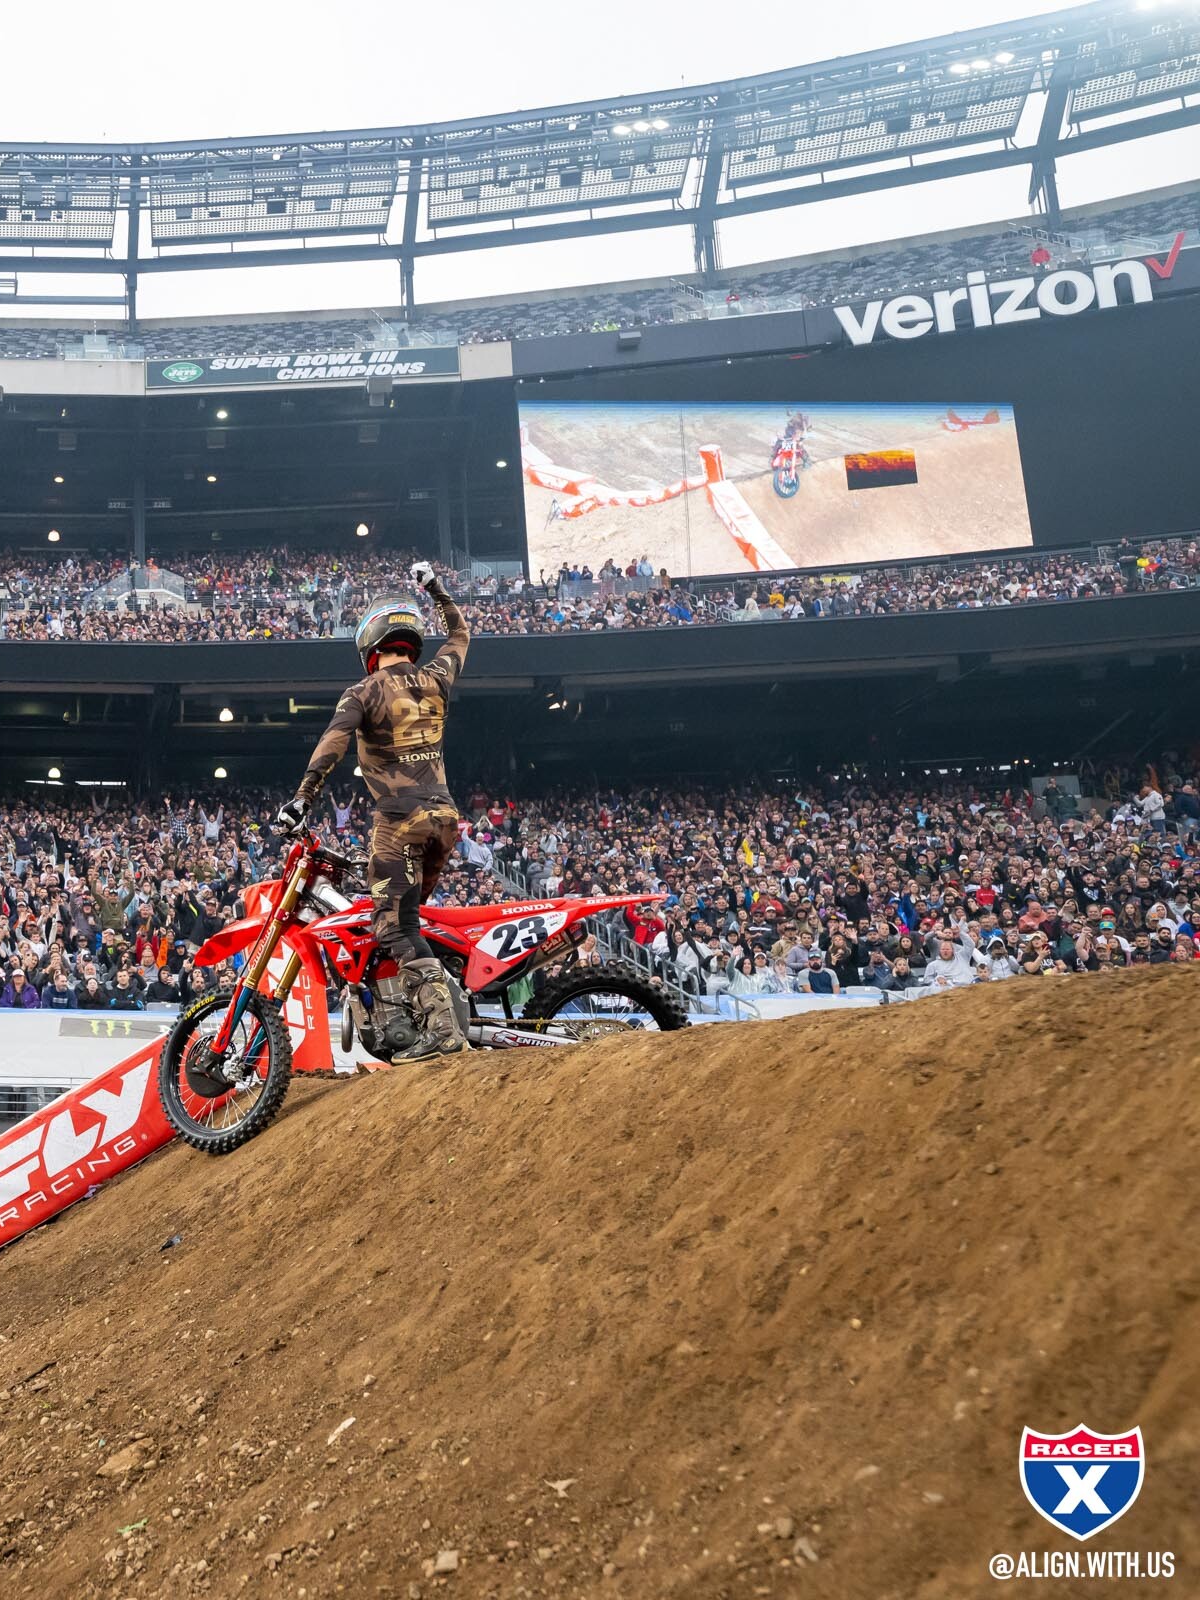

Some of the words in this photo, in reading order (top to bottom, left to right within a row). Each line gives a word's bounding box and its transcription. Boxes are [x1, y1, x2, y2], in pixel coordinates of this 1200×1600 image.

[833, 260, 1154, 346] verizon
[210, 355, 294, 370] SUPER
[298, 352, 364, 367] BOWL
[370, 350, 398, 363] III
[276, 362, 425, 380] CHAMPIONS
[388, 613, 416, 624] CHASE
[501, 903, 556, 916] HONDA
[492, 915, 549, 960] 23
[186, 996, 216, 1018] DUNLOP
